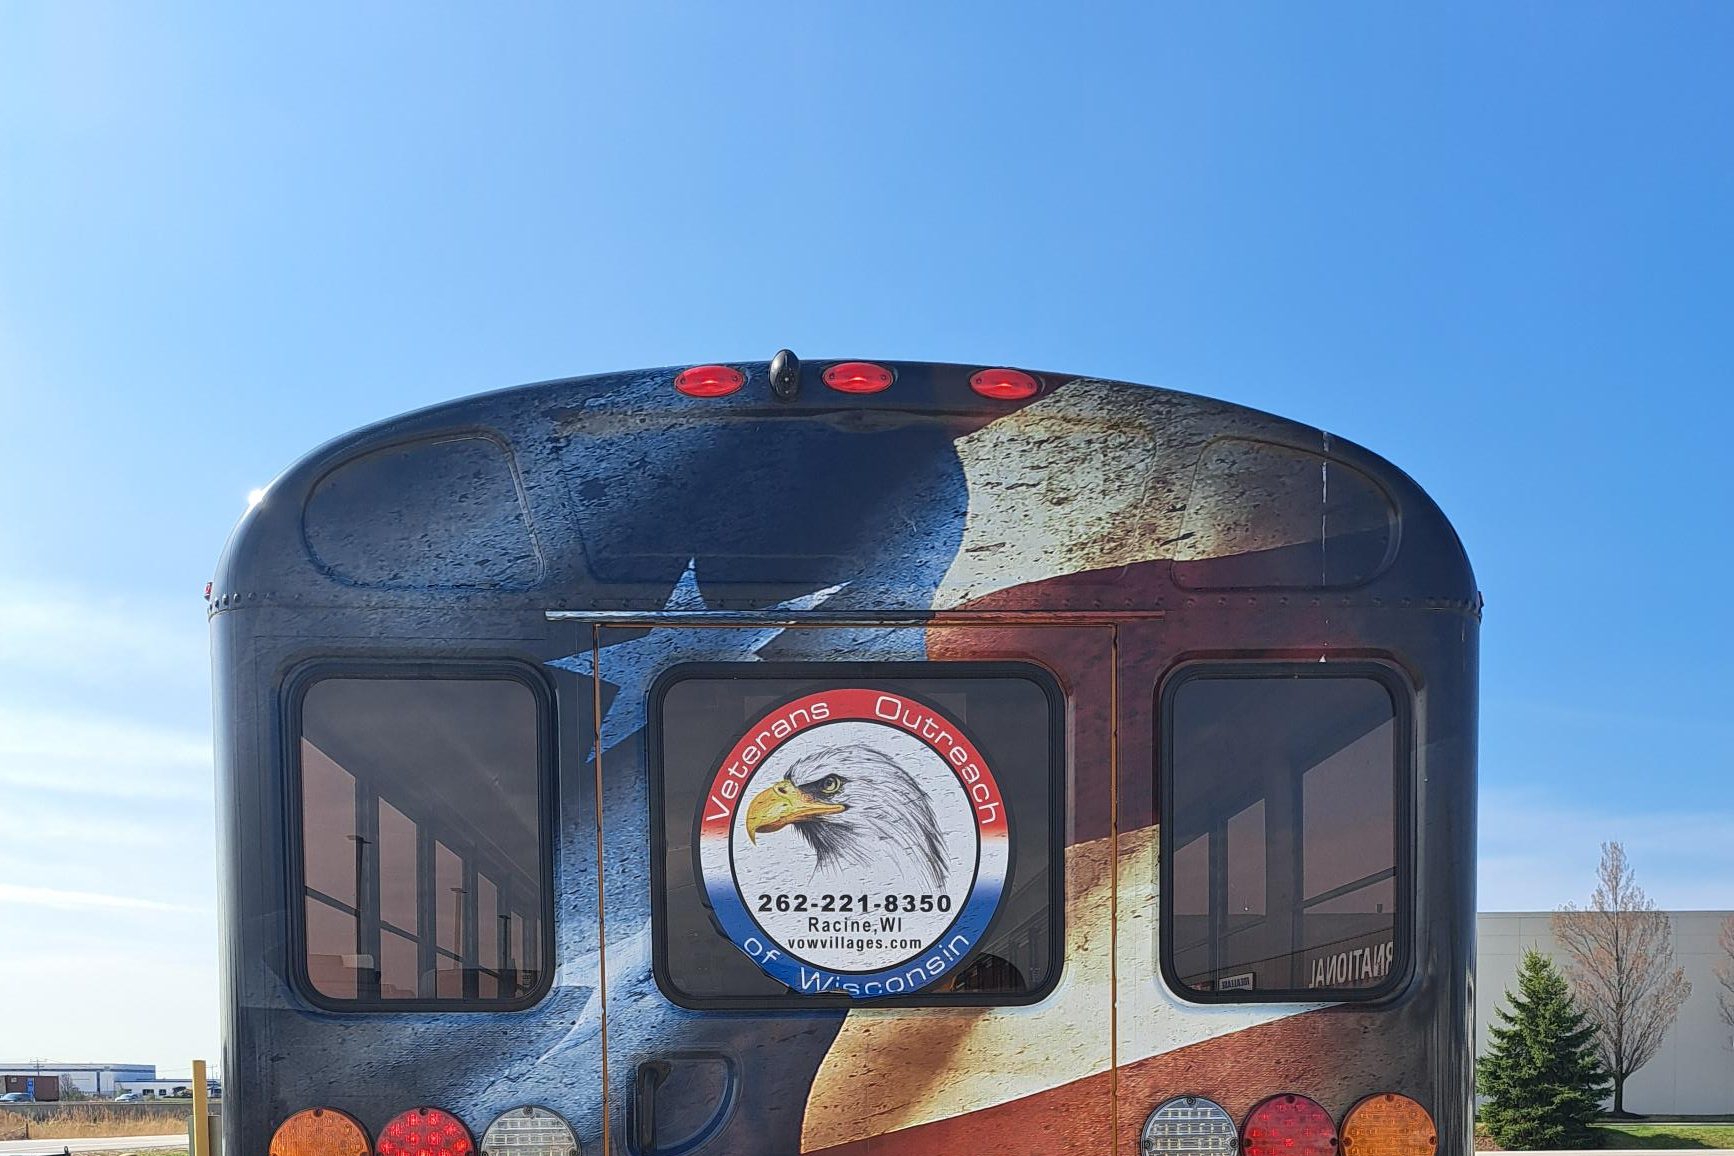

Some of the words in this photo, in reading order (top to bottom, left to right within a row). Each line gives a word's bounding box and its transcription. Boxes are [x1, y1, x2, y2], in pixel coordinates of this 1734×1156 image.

[705, 702, 830, 822] Veterans
[875, 695, 1000, 824] Outreach
[757, 894, 952, 913] 262-221-8350
[788, 936, 922, 951] vowvillages.com
[743, 937, 781, 964] of
[800, 934, 970, 995] Wisconsin
